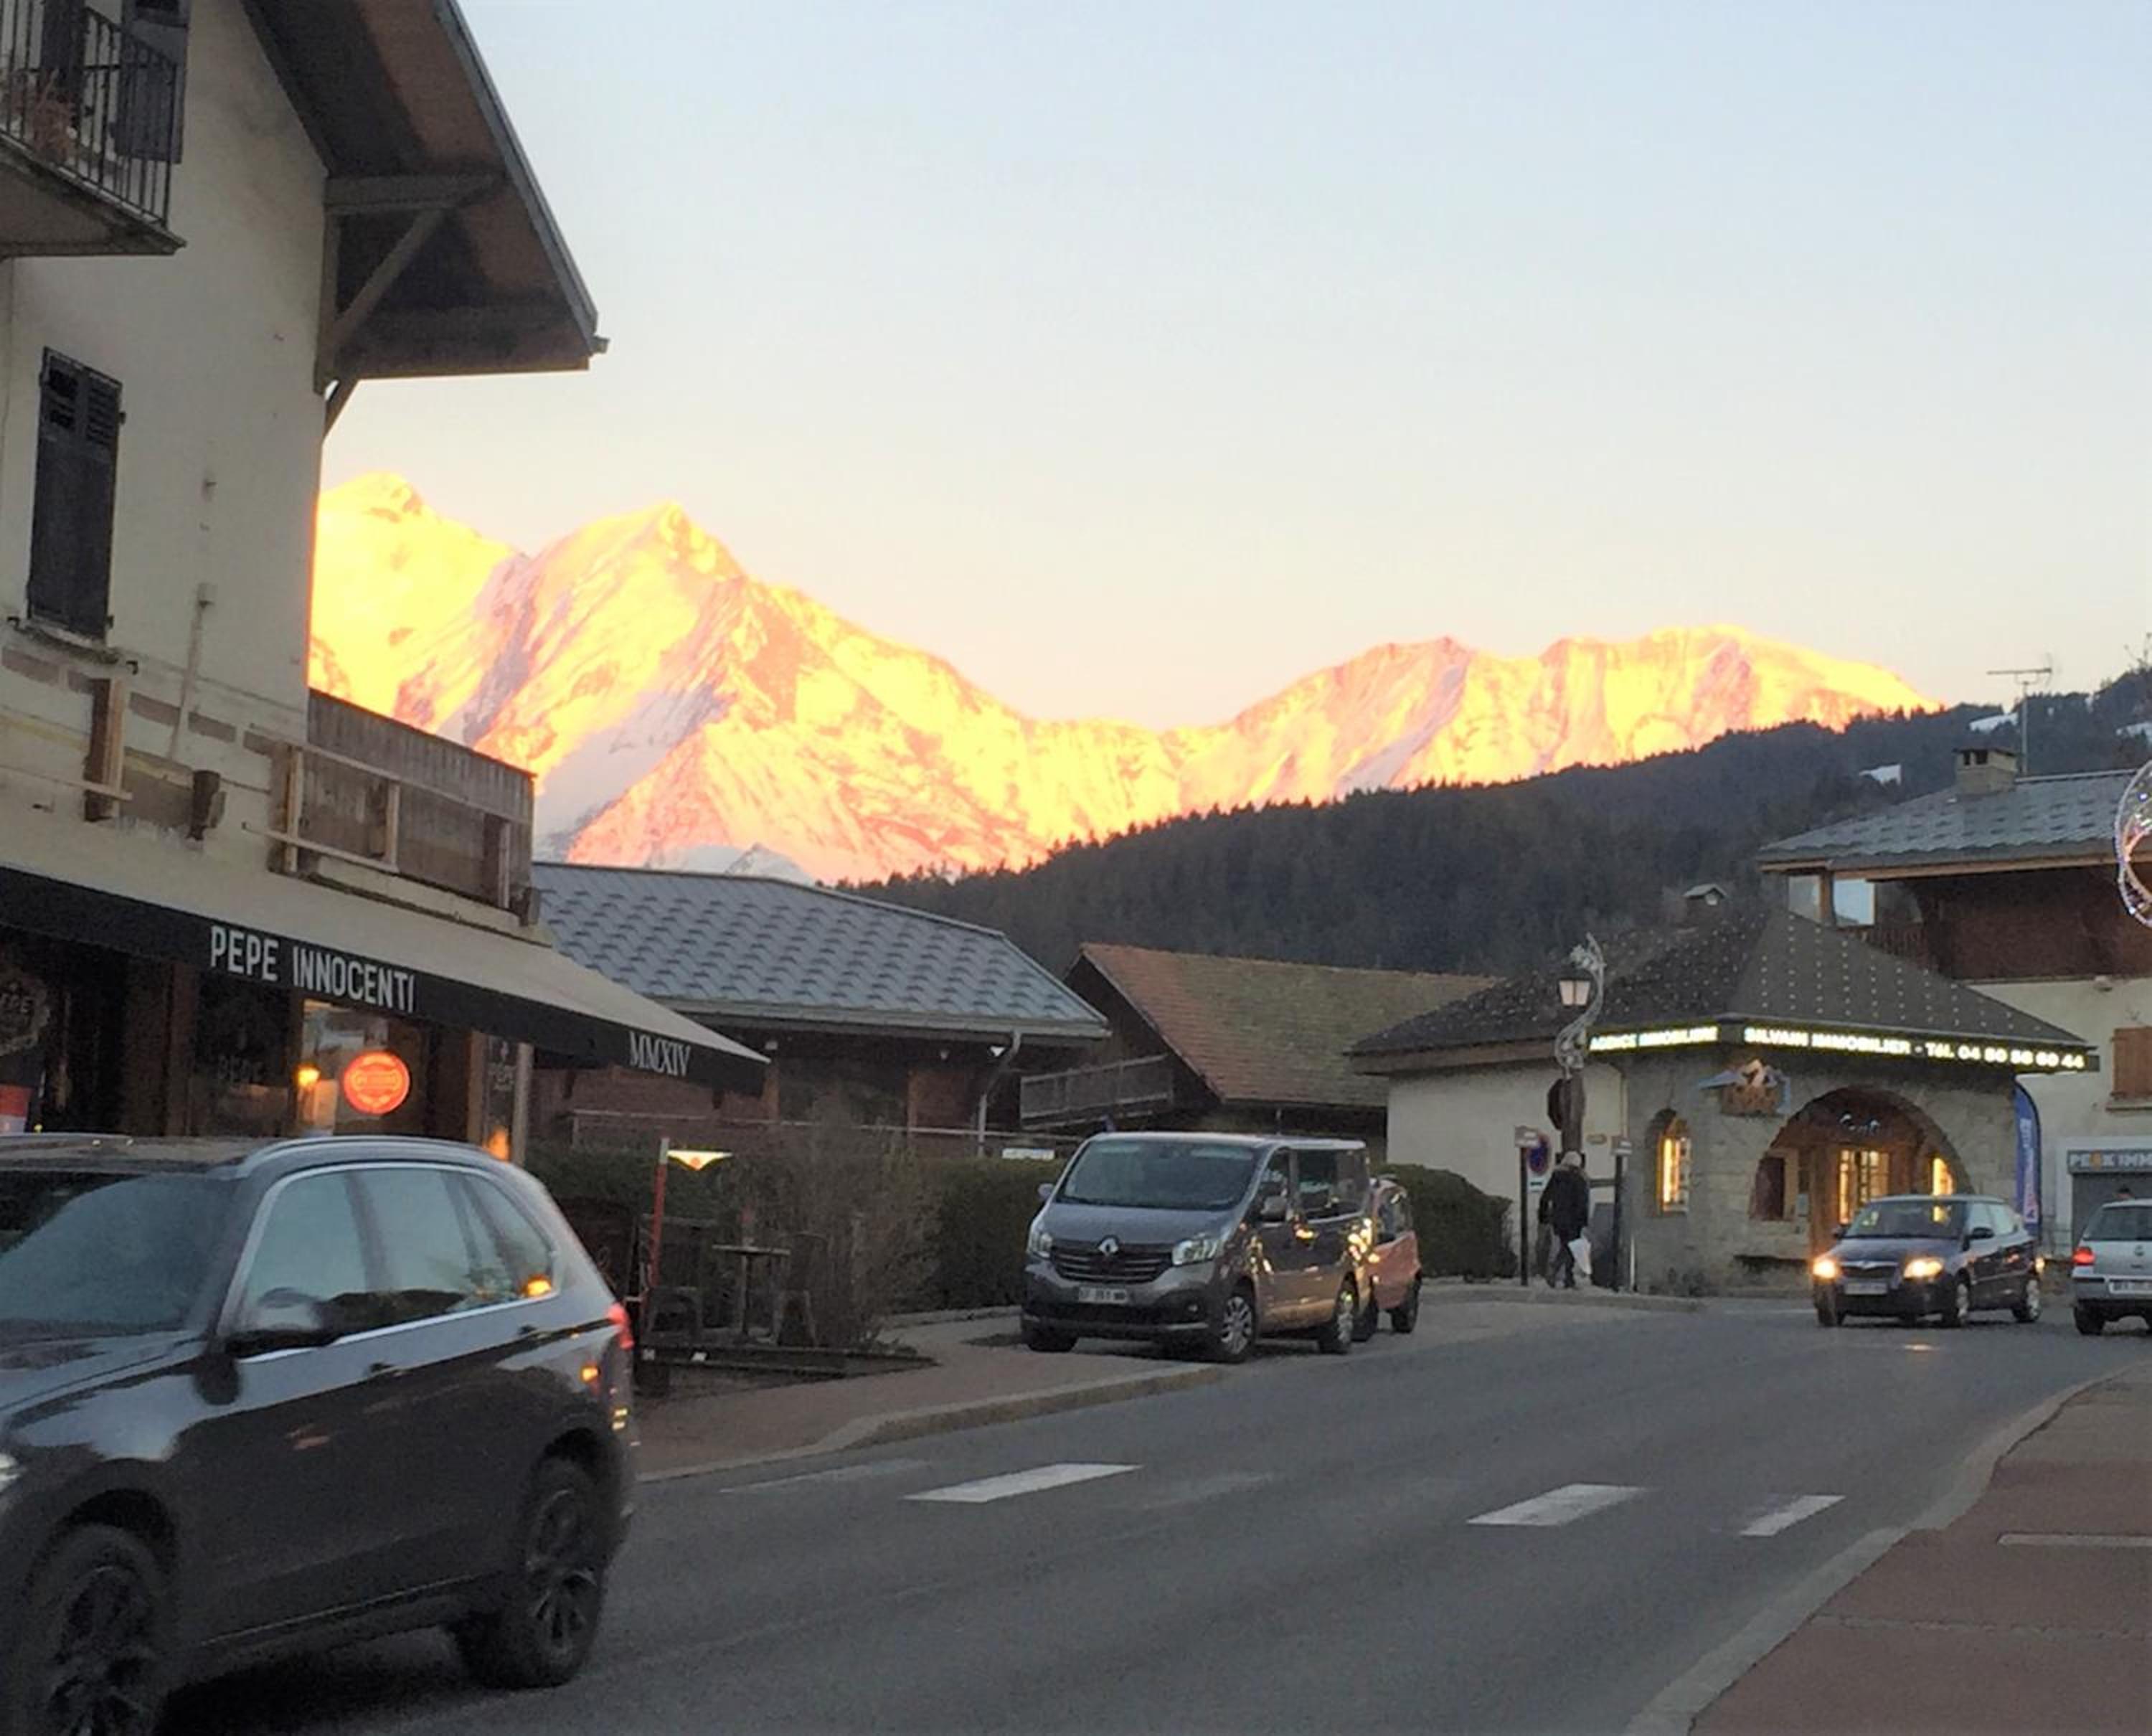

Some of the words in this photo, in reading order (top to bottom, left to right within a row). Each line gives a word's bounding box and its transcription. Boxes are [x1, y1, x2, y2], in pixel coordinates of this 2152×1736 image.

[211, 925, 278, 981] PEPE
[293, 946, 415, 1012] INNOCENTI
[1812, 1032, 1912, 1055] IMMOBILIER
[1958, 1045, 1981, 1060] 04
[2060, 1055, 2085, 1069] 44
